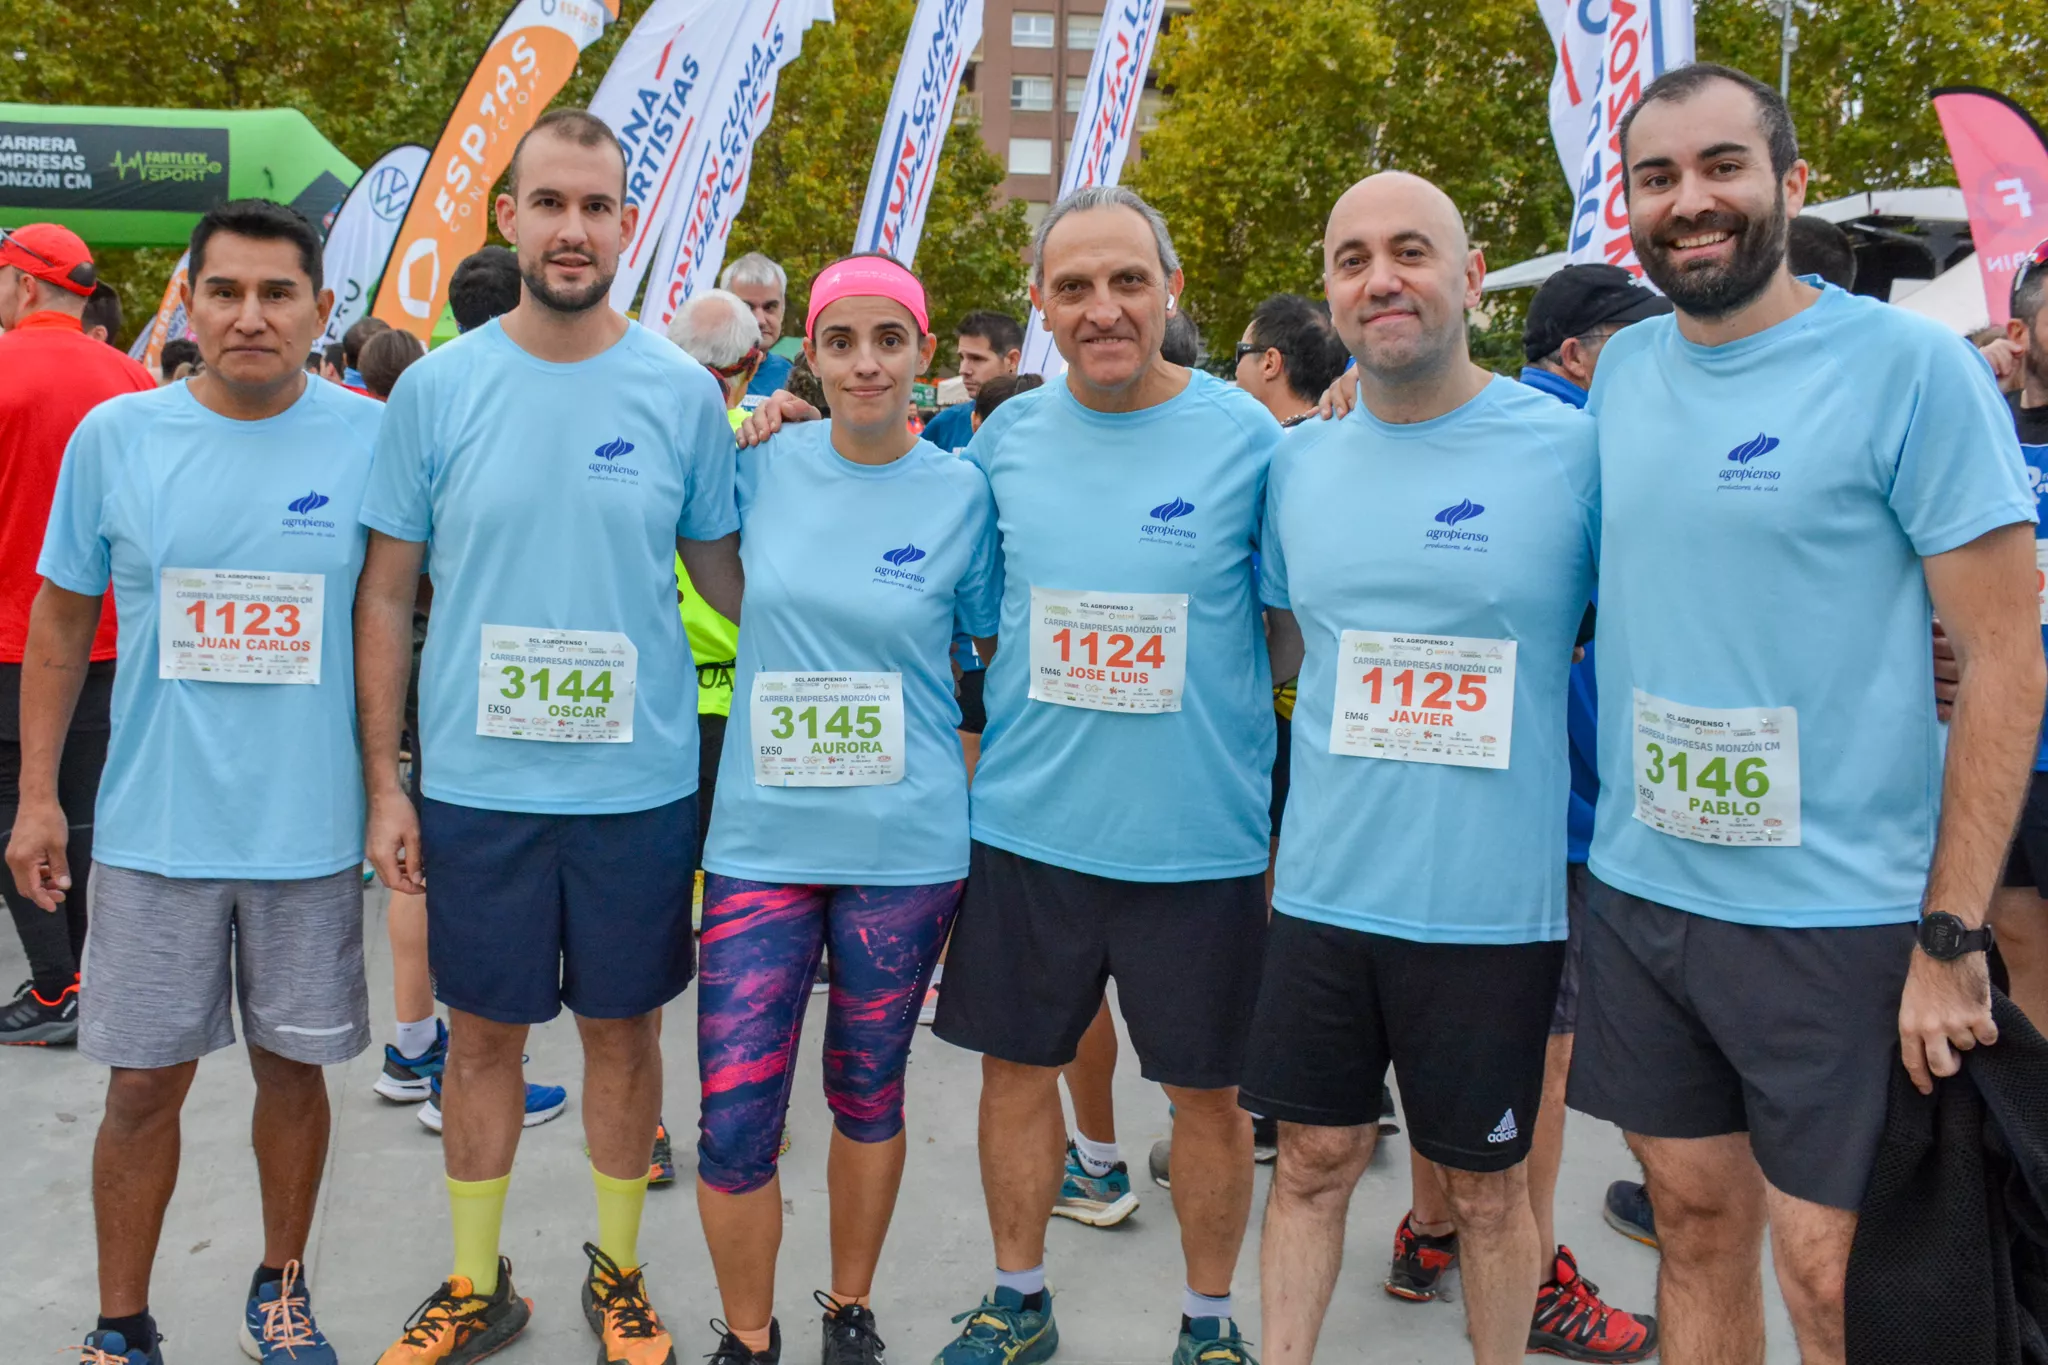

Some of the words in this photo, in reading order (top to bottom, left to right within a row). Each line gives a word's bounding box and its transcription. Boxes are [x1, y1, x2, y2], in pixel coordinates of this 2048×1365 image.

[720, 42, 762, 153] CUNA
[621, 87, 661, 169] UNA
[625, 53, 699, 208] RTISTAS
[0, 134, 77, 152] ARRERA
[0, 153, 86, 170] MPRESAS
[145, 151, 207, 165] FARTLECK
[0, 170, 60, 188] ONZÓN
[64, 173, 92, 189] CM
[148, 170, 206, 182] SPORT
[588, 462, 639, 476] agropienso
[1719, 466, 1781, 482] agropienso
[282, 517, 335, 528] agropienso
[1141, 525, 1197, 539] agropienso
[1426, 528, 1489, 542] agropienso
[875, 566, 925, 583] agropienso
[186, 600, 301, 637] 1123
[1044, 617, 1079, 629] CARRERA
[1080, 623, 1124, 633] EMPRESAS
[1125, 622, 1163, 634] MONZÓN
[172, 640, 195, 648] EM46
[197, 637, 240, 649] JUAN
[246, 639, 311, 652] CARLOS
[1052, 628, 1166, 669] 1124
[1406, 638, 1449, 646] AGROPIENSO
[490, 653, 526, 663] CARRERA
[528, 655, 573, 666] EMPRESAS
[575, 657, 611, 667] MONZÓN
[612, 660, 625, 668] CM
[1353, 656, 1392, 667] CARRERA
[1393, 659, 1442, 671] EMPRESAS
[1444, 661, 1486, 674] MONZÓN
[1488, 666, 1502, 674] CM
[1040, 666, 1061, 676] EM46
[1066, 666, 1106, 681] JOSE
[1111, 671, 1149, 684] LUIS
[500, 665, 614, 704] 3144
[1362, 667, 1487, 712] 1125
[759, 695, 795, 703] CARRERA
[796, 694, 839, 703] EMPRESAS
[841, 693, 877, 702] MONZÓN
[488, 704, 511, 715] EX50
[548, 704, 606, 718] OSCAR
[1345, 712, 1369, 721] EM46
[770, 705, 882, 739] 3145
[1388, 710, 1454, 727] JAVIER
[1666, 713, 1676, 721] SCL
[1677, 716, 1724, 728] AGROPIENSO
[1638, 724, 1665, 741] CARRERA
[1666, 735, 1713, 752] EMPRESAS
[1716, 741, 1762, 753] MONZÓN
[1764, 741, 1780, 751] CM
[760, 746, 782, 755] EX50
[811, 741, 883, 754] AURORA
[1645, 742, 1770, 798] 3146
[1639, 784, 1654, 801] EX50
[1689, 797, 1760, 816] PABLO
